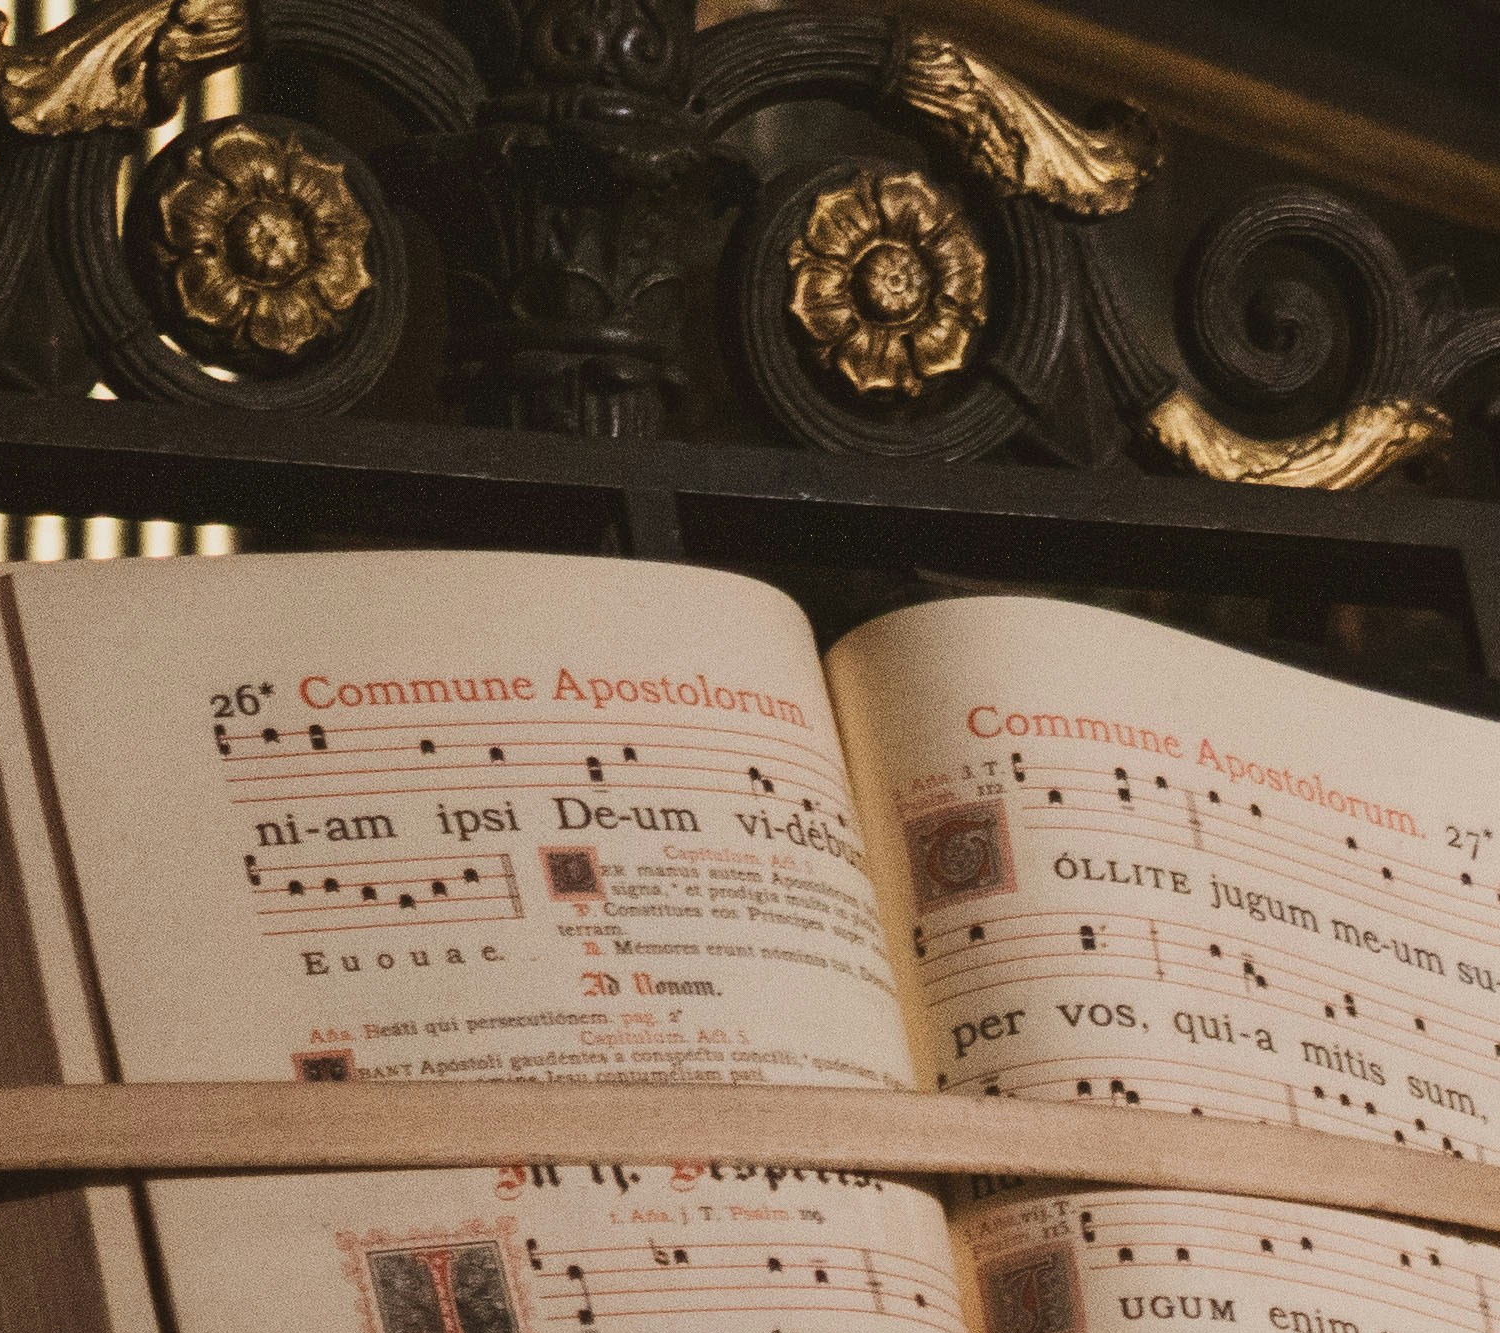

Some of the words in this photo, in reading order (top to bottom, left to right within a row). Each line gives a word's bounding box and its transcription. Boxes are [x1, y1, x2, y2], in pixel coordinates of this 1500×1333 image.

[299, 676, 536, 709] Commune
[966, 705, 1184, 758] Commune
[1197, 738, 1427, 839] Apostolorum.
[436, 800, 521, 842] ipsi
[552, 797, 701, 833] De-um
[1209, 873, 1320, 935] jugum
[581, 970, 620, 996] Ad
[425, 1018, 459, 1037] qui
[950, 1004, 1026, 1057] per
[1057, 1001, 1150, 1033] vos,
[1300, 1038, 1387, 1088] mitis
[1407, 1072, 1489, 1124] sum,
[1119, 1296, 1236, 1323] UGUM
